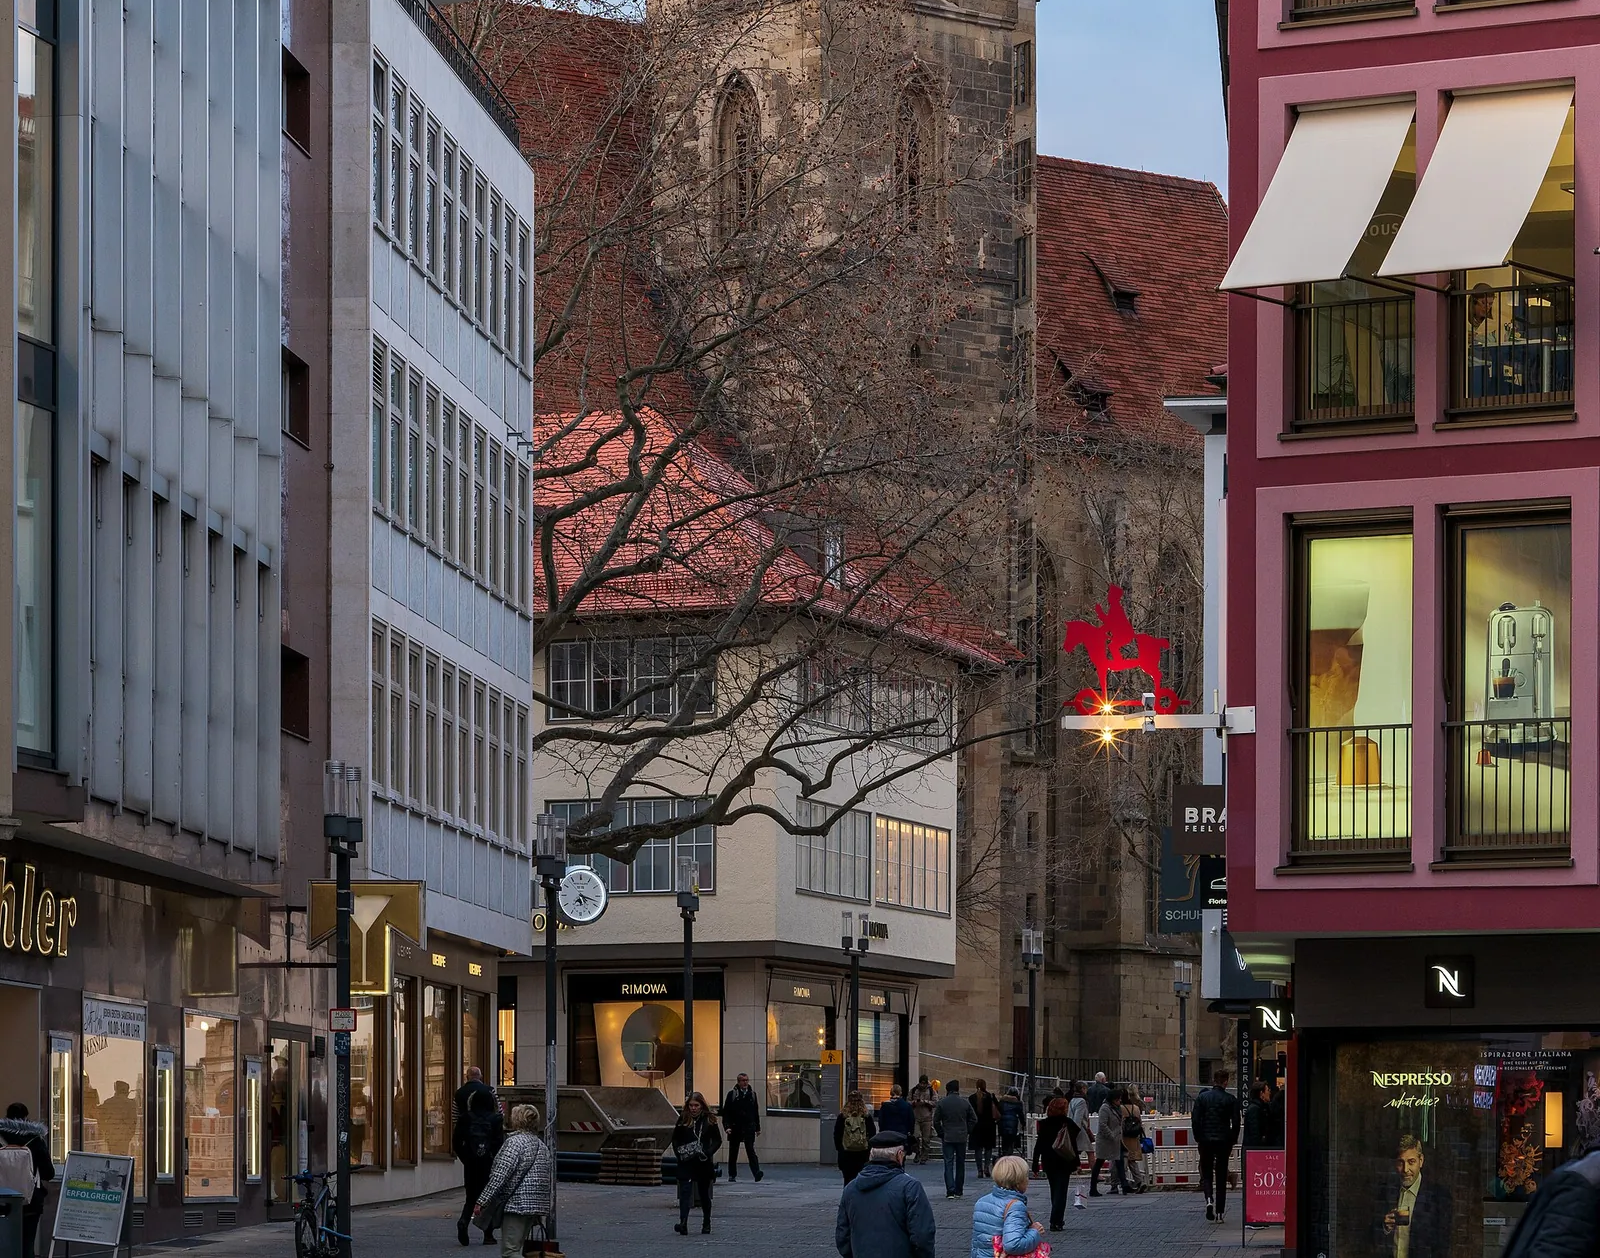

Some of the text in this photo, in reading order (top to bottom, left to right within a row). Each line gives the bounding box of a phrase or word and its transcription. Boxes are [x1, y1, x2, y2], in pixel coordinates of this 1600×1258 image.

[1185, 825, 1213, 833] FEEL
[621, 983, 668, 995] RIMOWA
[1431, 965, 1466, 997] N
[1255, 1005, 1287, 1032] N
[1369, 1070, 1452, 1088] NESPRESSO
[1253, 1172, 1287, 1188] 50%
[66, 1189, 121, 1202] ERFOLGREICH!
